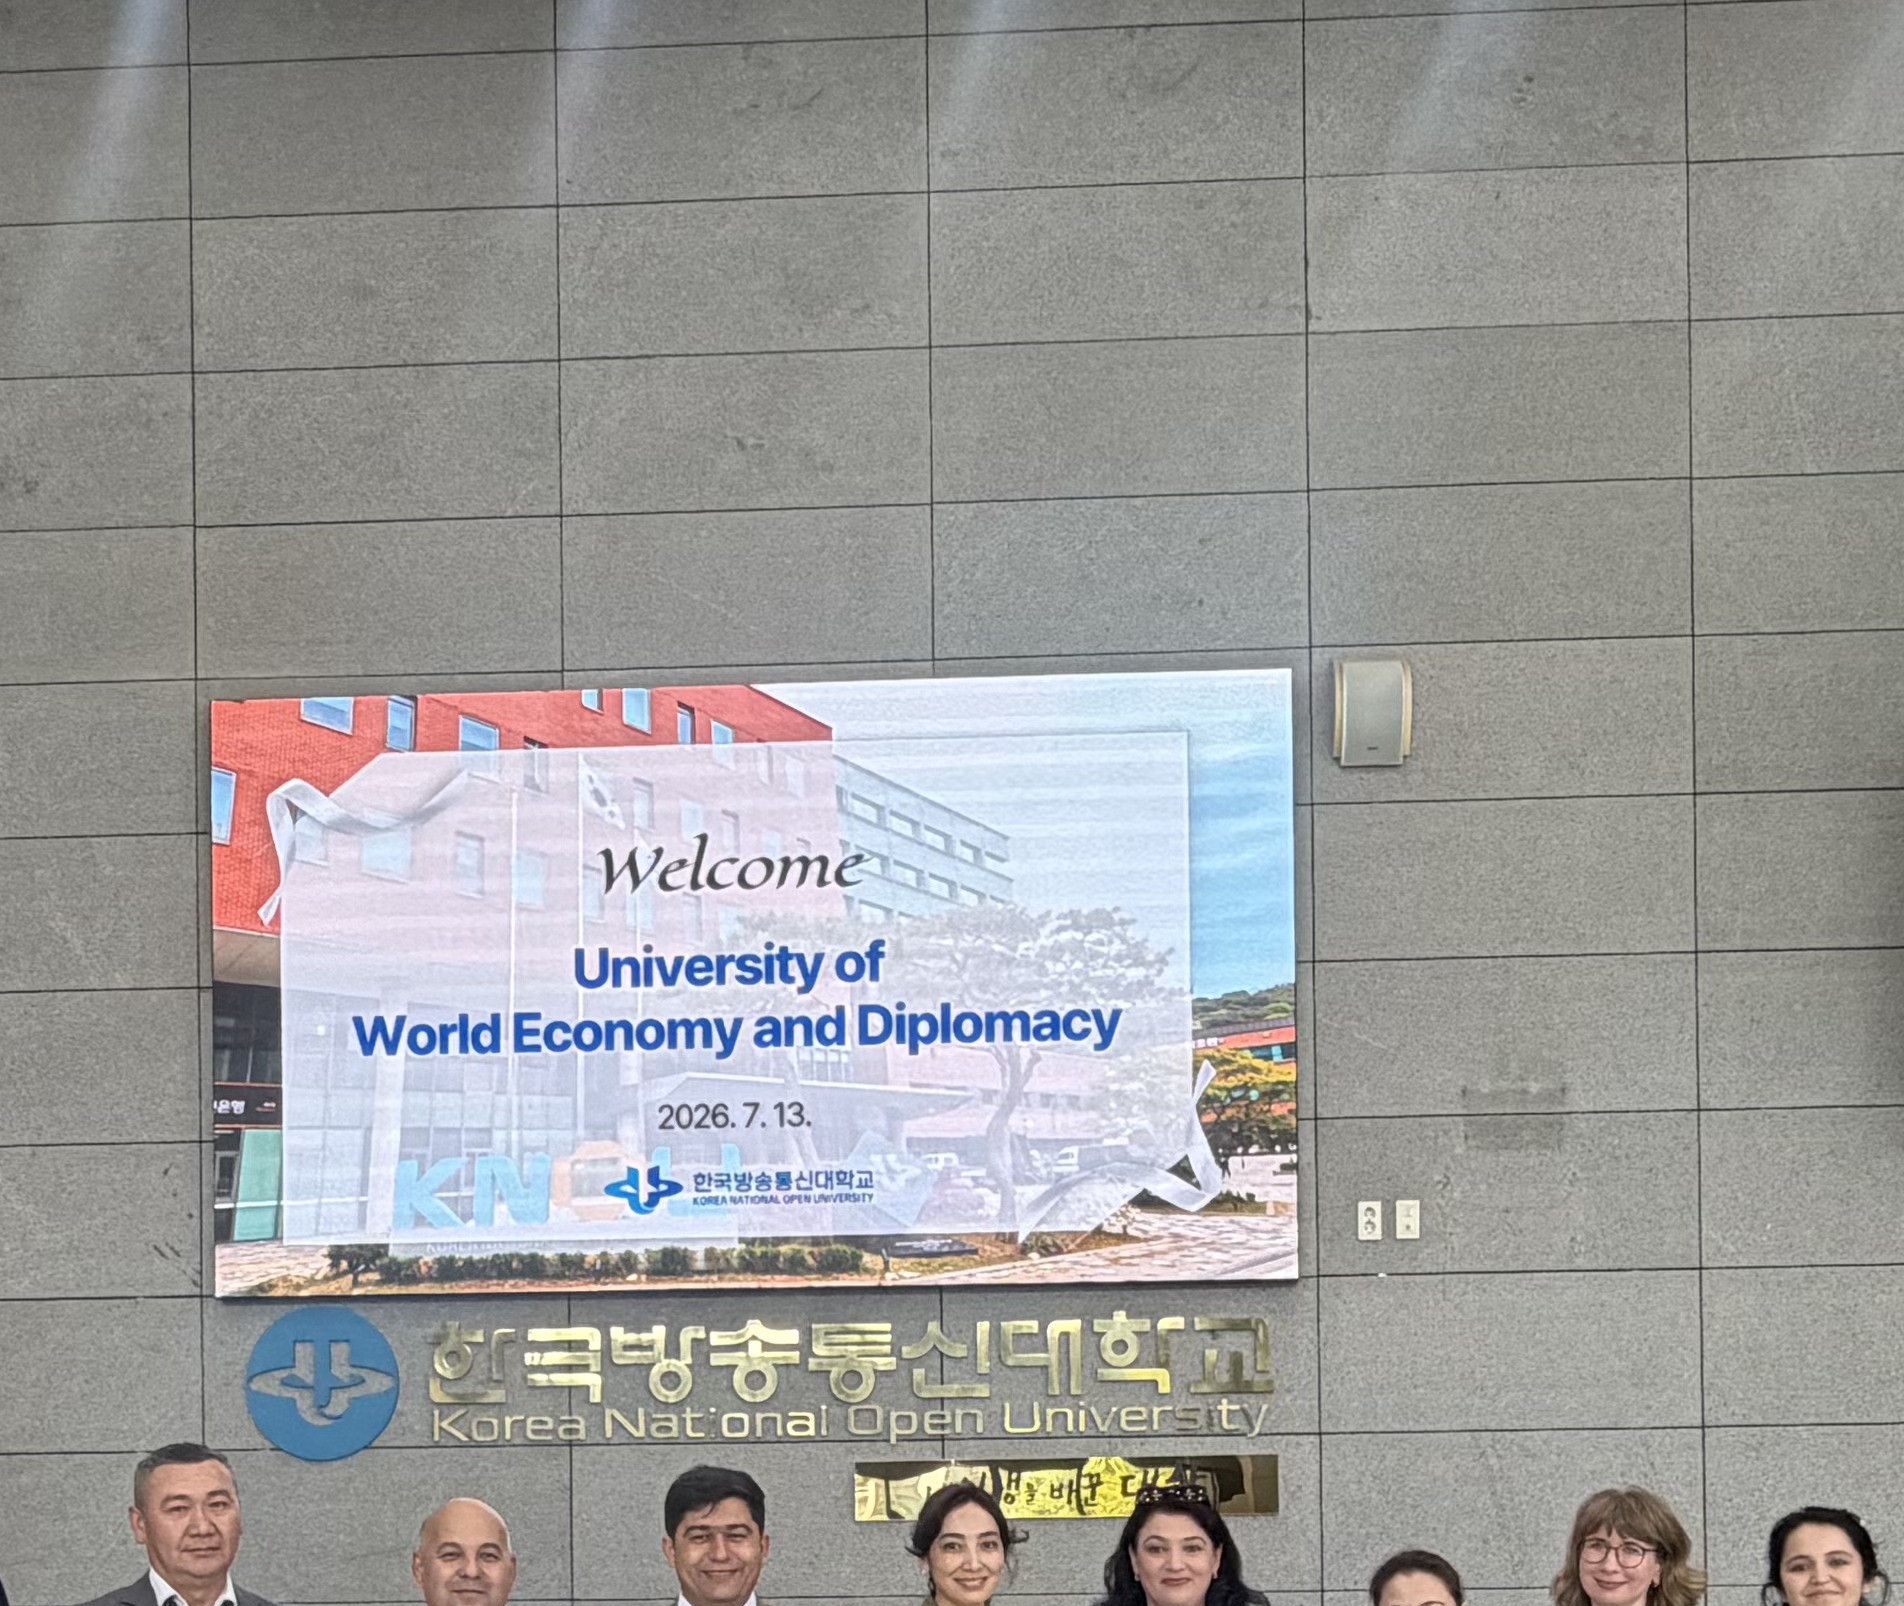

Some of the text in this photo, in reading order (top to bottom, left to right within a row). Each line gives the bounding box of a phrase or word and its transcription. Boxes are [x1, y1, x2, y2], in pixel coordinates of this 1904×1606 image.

[597, 832, 873, 894] Welcome
[574, 938, 886, 995] University of
[351, 1001, 1124, 1060] World Economy and Diplomacy
[657, 1101, 813, 1131] 2026. 7. 13.
[692, 1169, 875, 1194] 한국방송통신대학교
[692, 1192, 875, 1207] KOREA NATIONAL OPEN UNIVERSITY
[427, 1311, 1274, 1403] 한국방송통신대학교
[432, 1398, 1269, 1444] Korea National Open University
